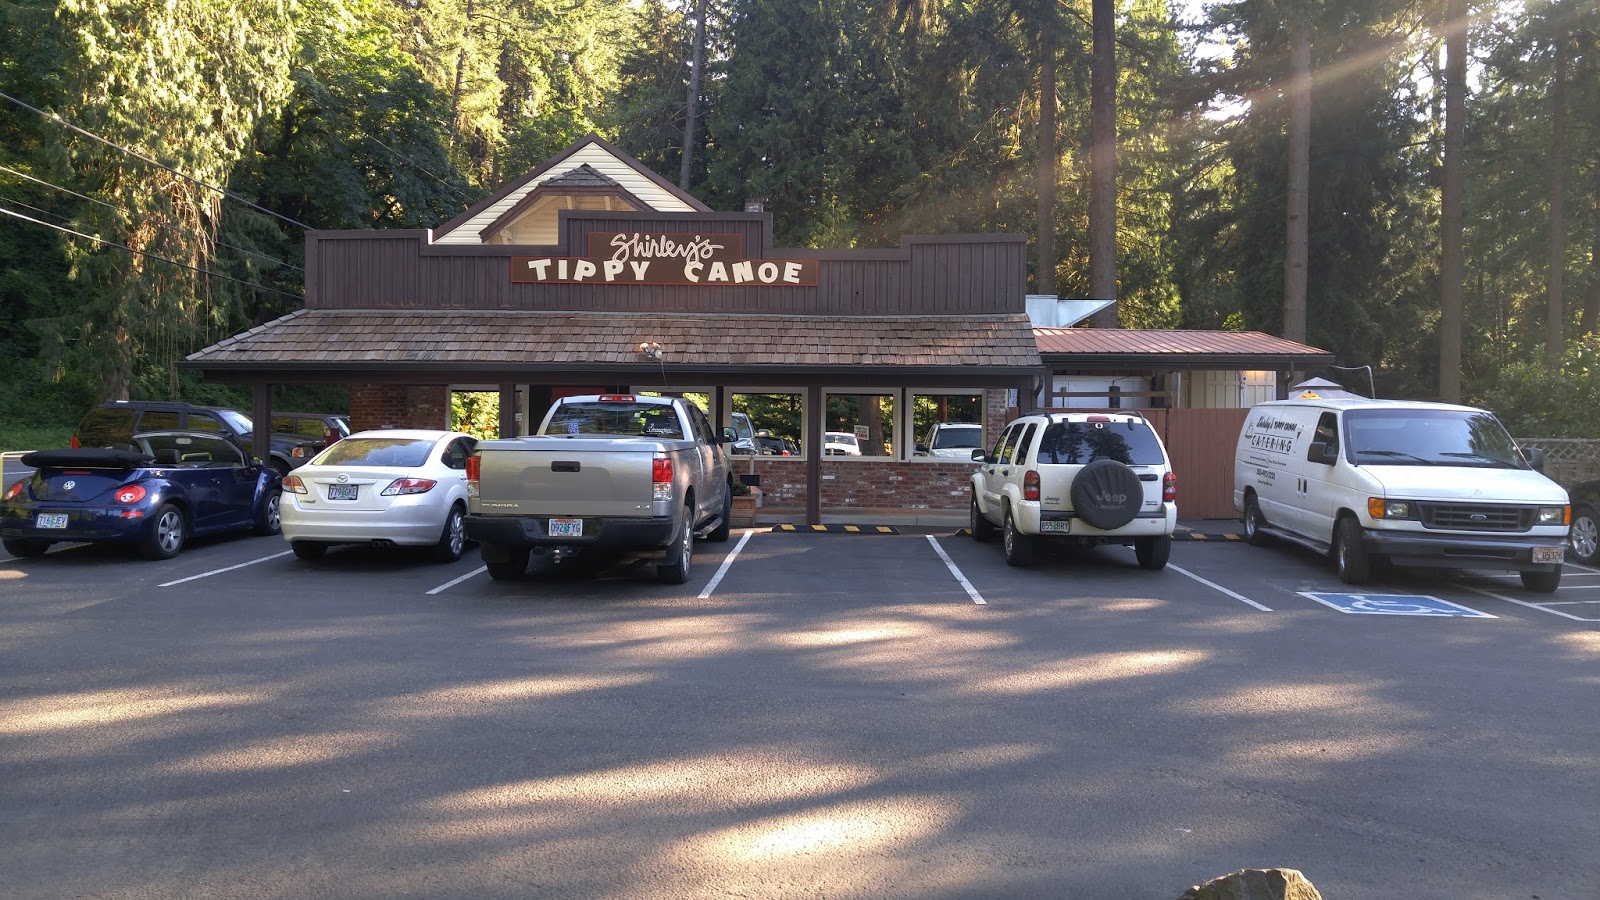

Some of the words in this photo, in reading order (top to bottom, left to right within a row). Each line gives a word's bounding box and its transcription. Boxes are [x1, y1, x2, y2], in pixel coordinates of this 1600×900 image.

[610, 232, 724, 265] Shirley's
[528, 258, 650, 282] TIPPY
[684, 260, 803, 284] CANOE
[1096, 490, 1127, 504] Jeep
